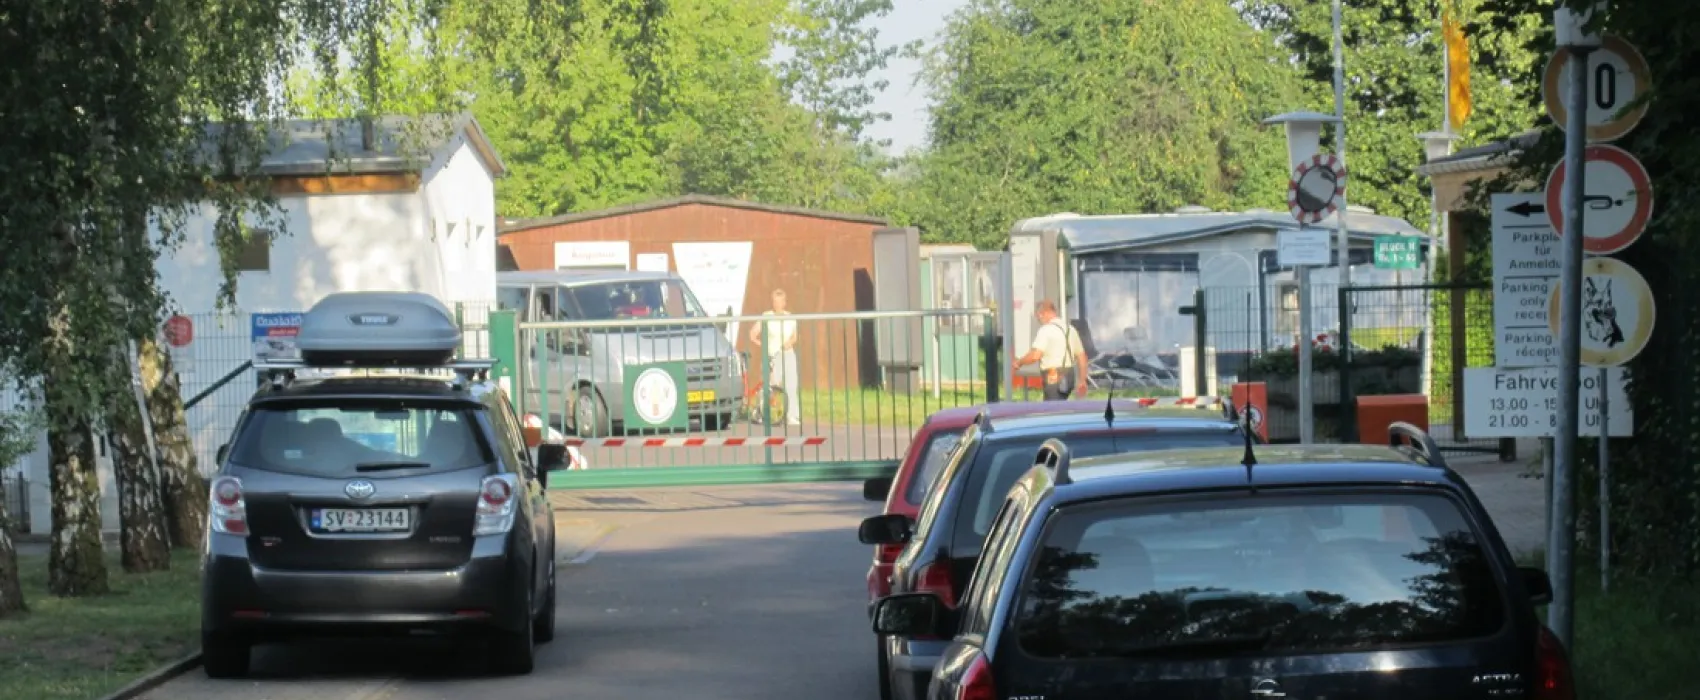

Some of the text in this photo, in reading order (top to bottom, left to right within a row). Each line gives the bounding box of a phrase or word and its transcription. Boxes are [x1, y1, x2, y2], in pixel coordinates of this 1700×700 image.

[1512, 231, 1560, 245] Parkpla
[1509, 259, 1561, 269] Anmeldu
[1502, 282, 1548, 294] Parking
[1520, 297, 1546, 308] only
[1504, 333, 1553, 346] Parking
[1490, 398, 1528, 411] 13.00
[1488, 414, 1528, 428] 21.00
[325, 510, 405, 528] SV 23144
